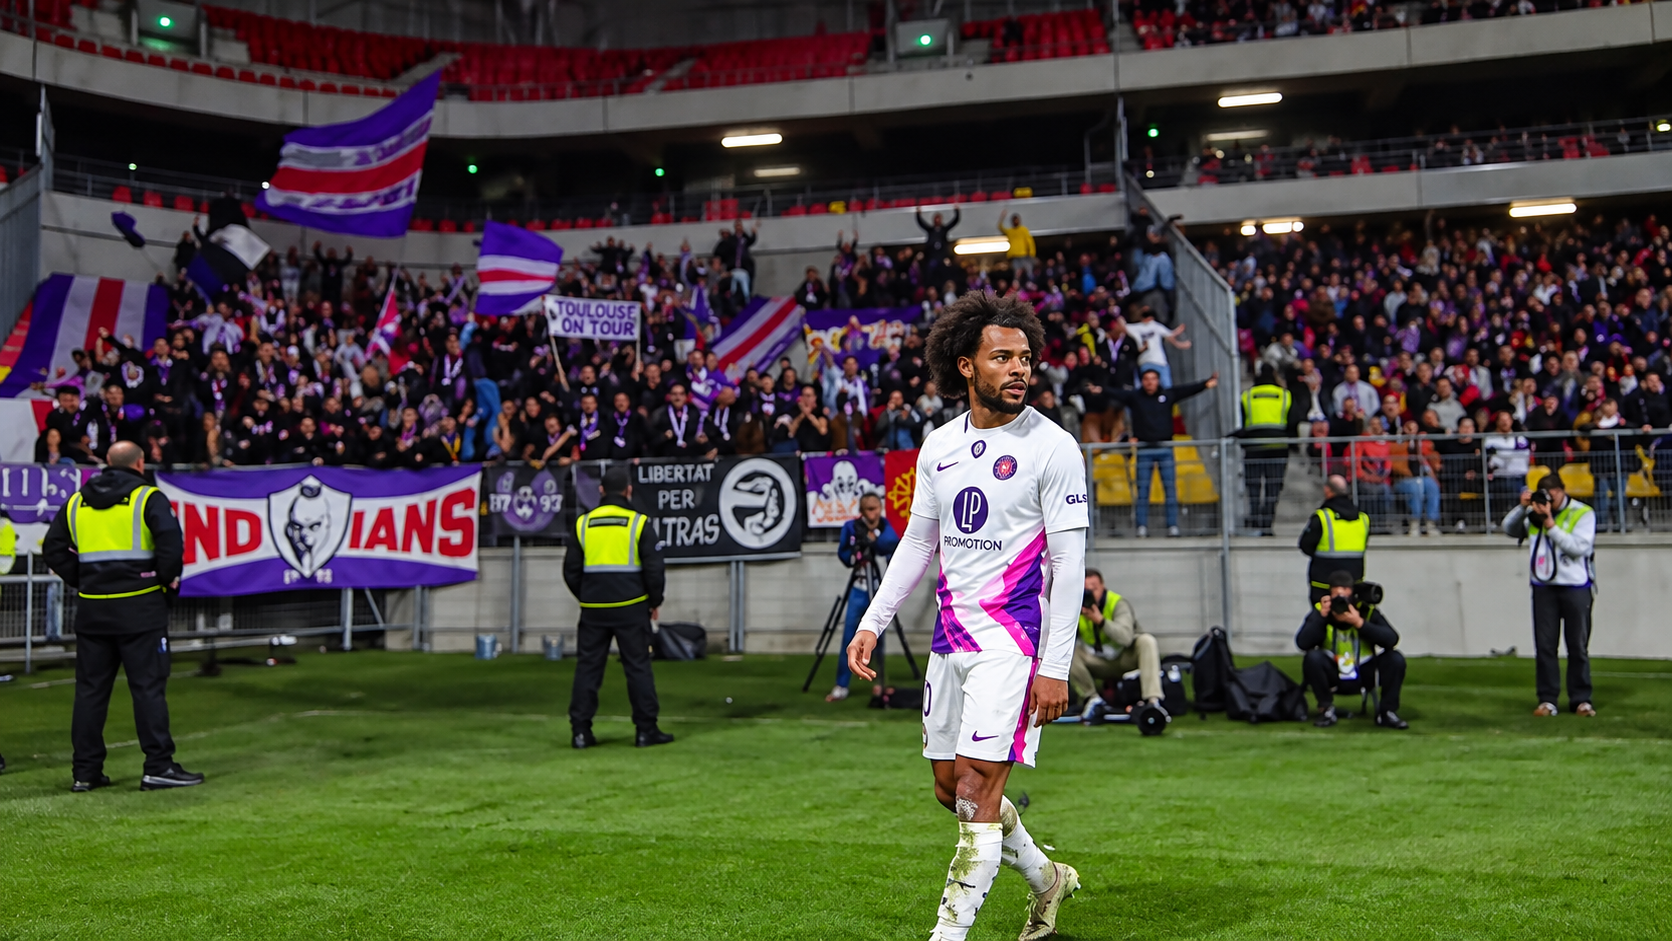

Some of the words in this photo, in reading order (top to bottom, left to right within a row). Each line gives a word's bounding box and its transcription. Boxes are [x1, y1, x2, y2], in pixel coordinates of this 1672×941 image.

[555, 300, 636, 320] TOULOUSE
[562, 317, 584, 334] ON
[590, 320, 634, 336] TOUR
[638, 463, 715, 484] LIBERTAT
[657, 488, 695, 510] PER
[1065, 493, 1087, 505] GLS
[170, 500, 263, 566] ND
[349, 487, 476, 557] IANS
[647, 513, 720, 547] LTRAS
[944, 534, 1002, 551] PROMOTION
